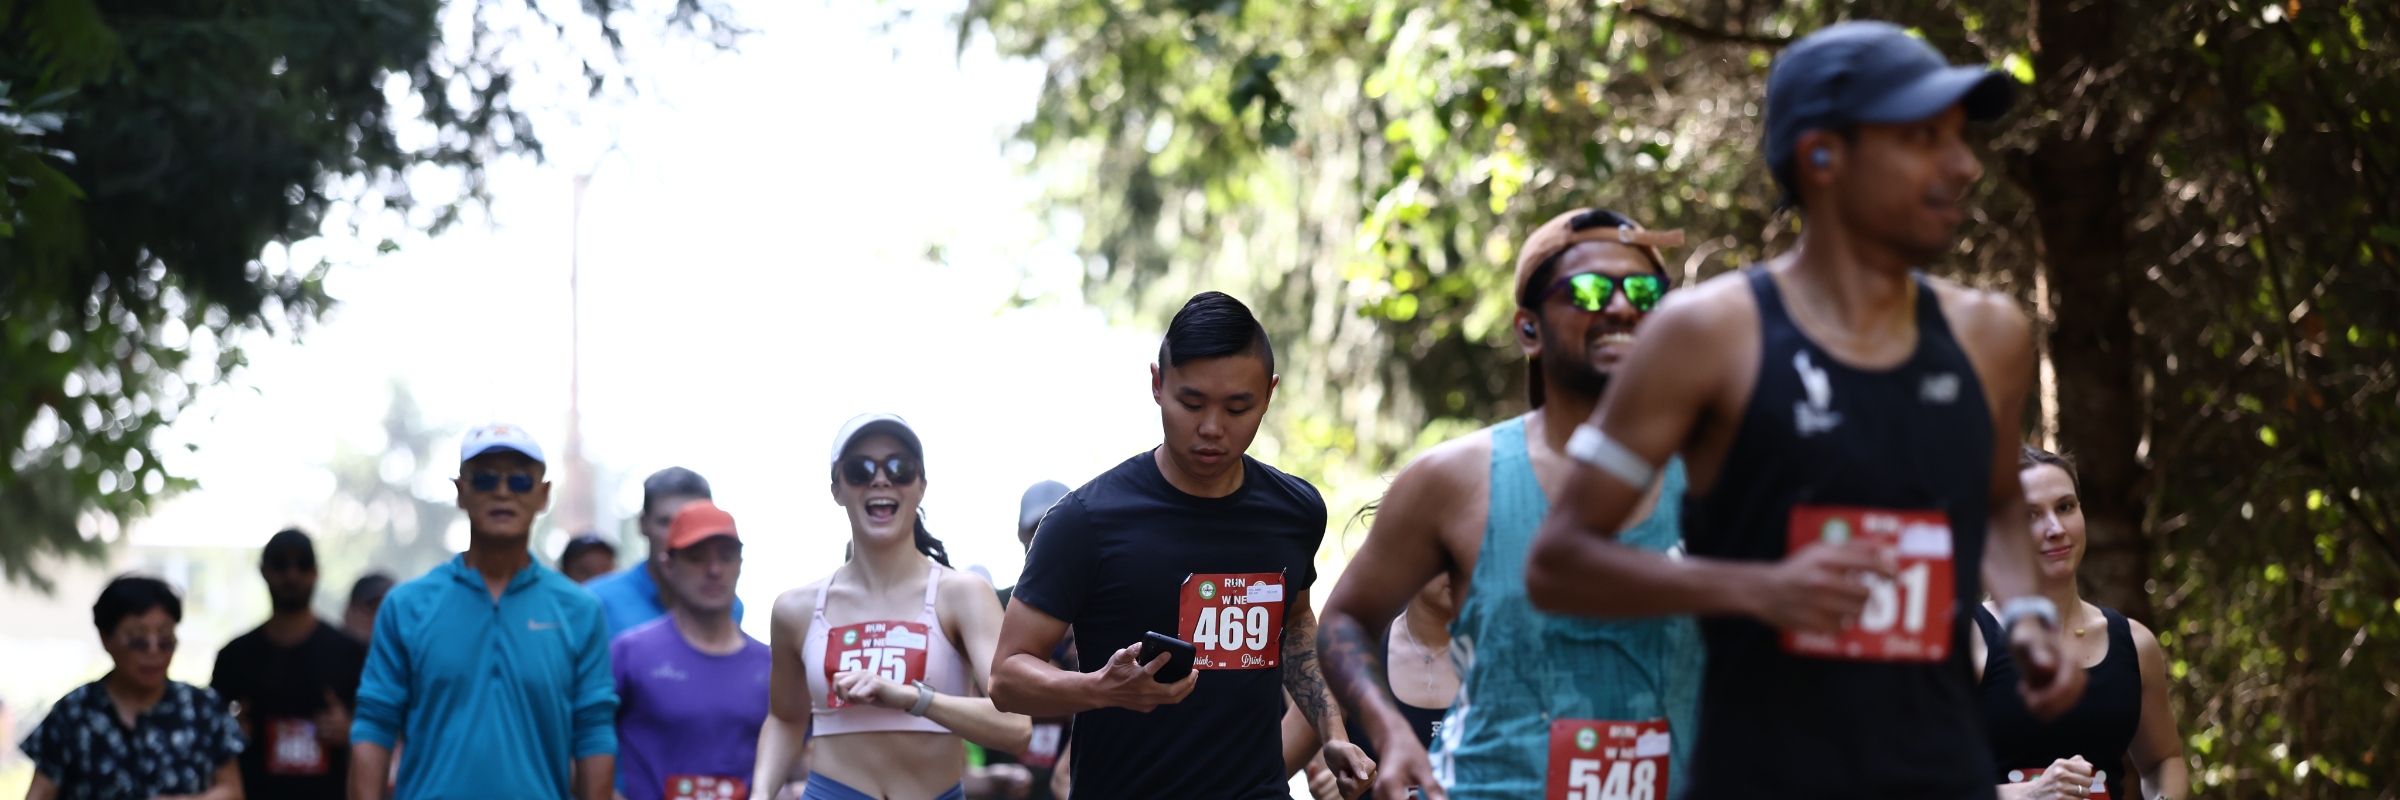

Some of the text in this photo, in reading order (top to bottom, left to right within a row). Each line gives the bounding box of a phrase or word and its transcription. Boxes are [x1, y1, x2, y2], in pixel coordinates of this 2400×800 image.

[1224, 578, 1246, 588] RUN
[1193, 606, 1269, 651] 469
[1193, 654, 1214, 668] rink
[1241, 653, 1266, 668] Drink
[1566, 758, 1658, 800] 548
